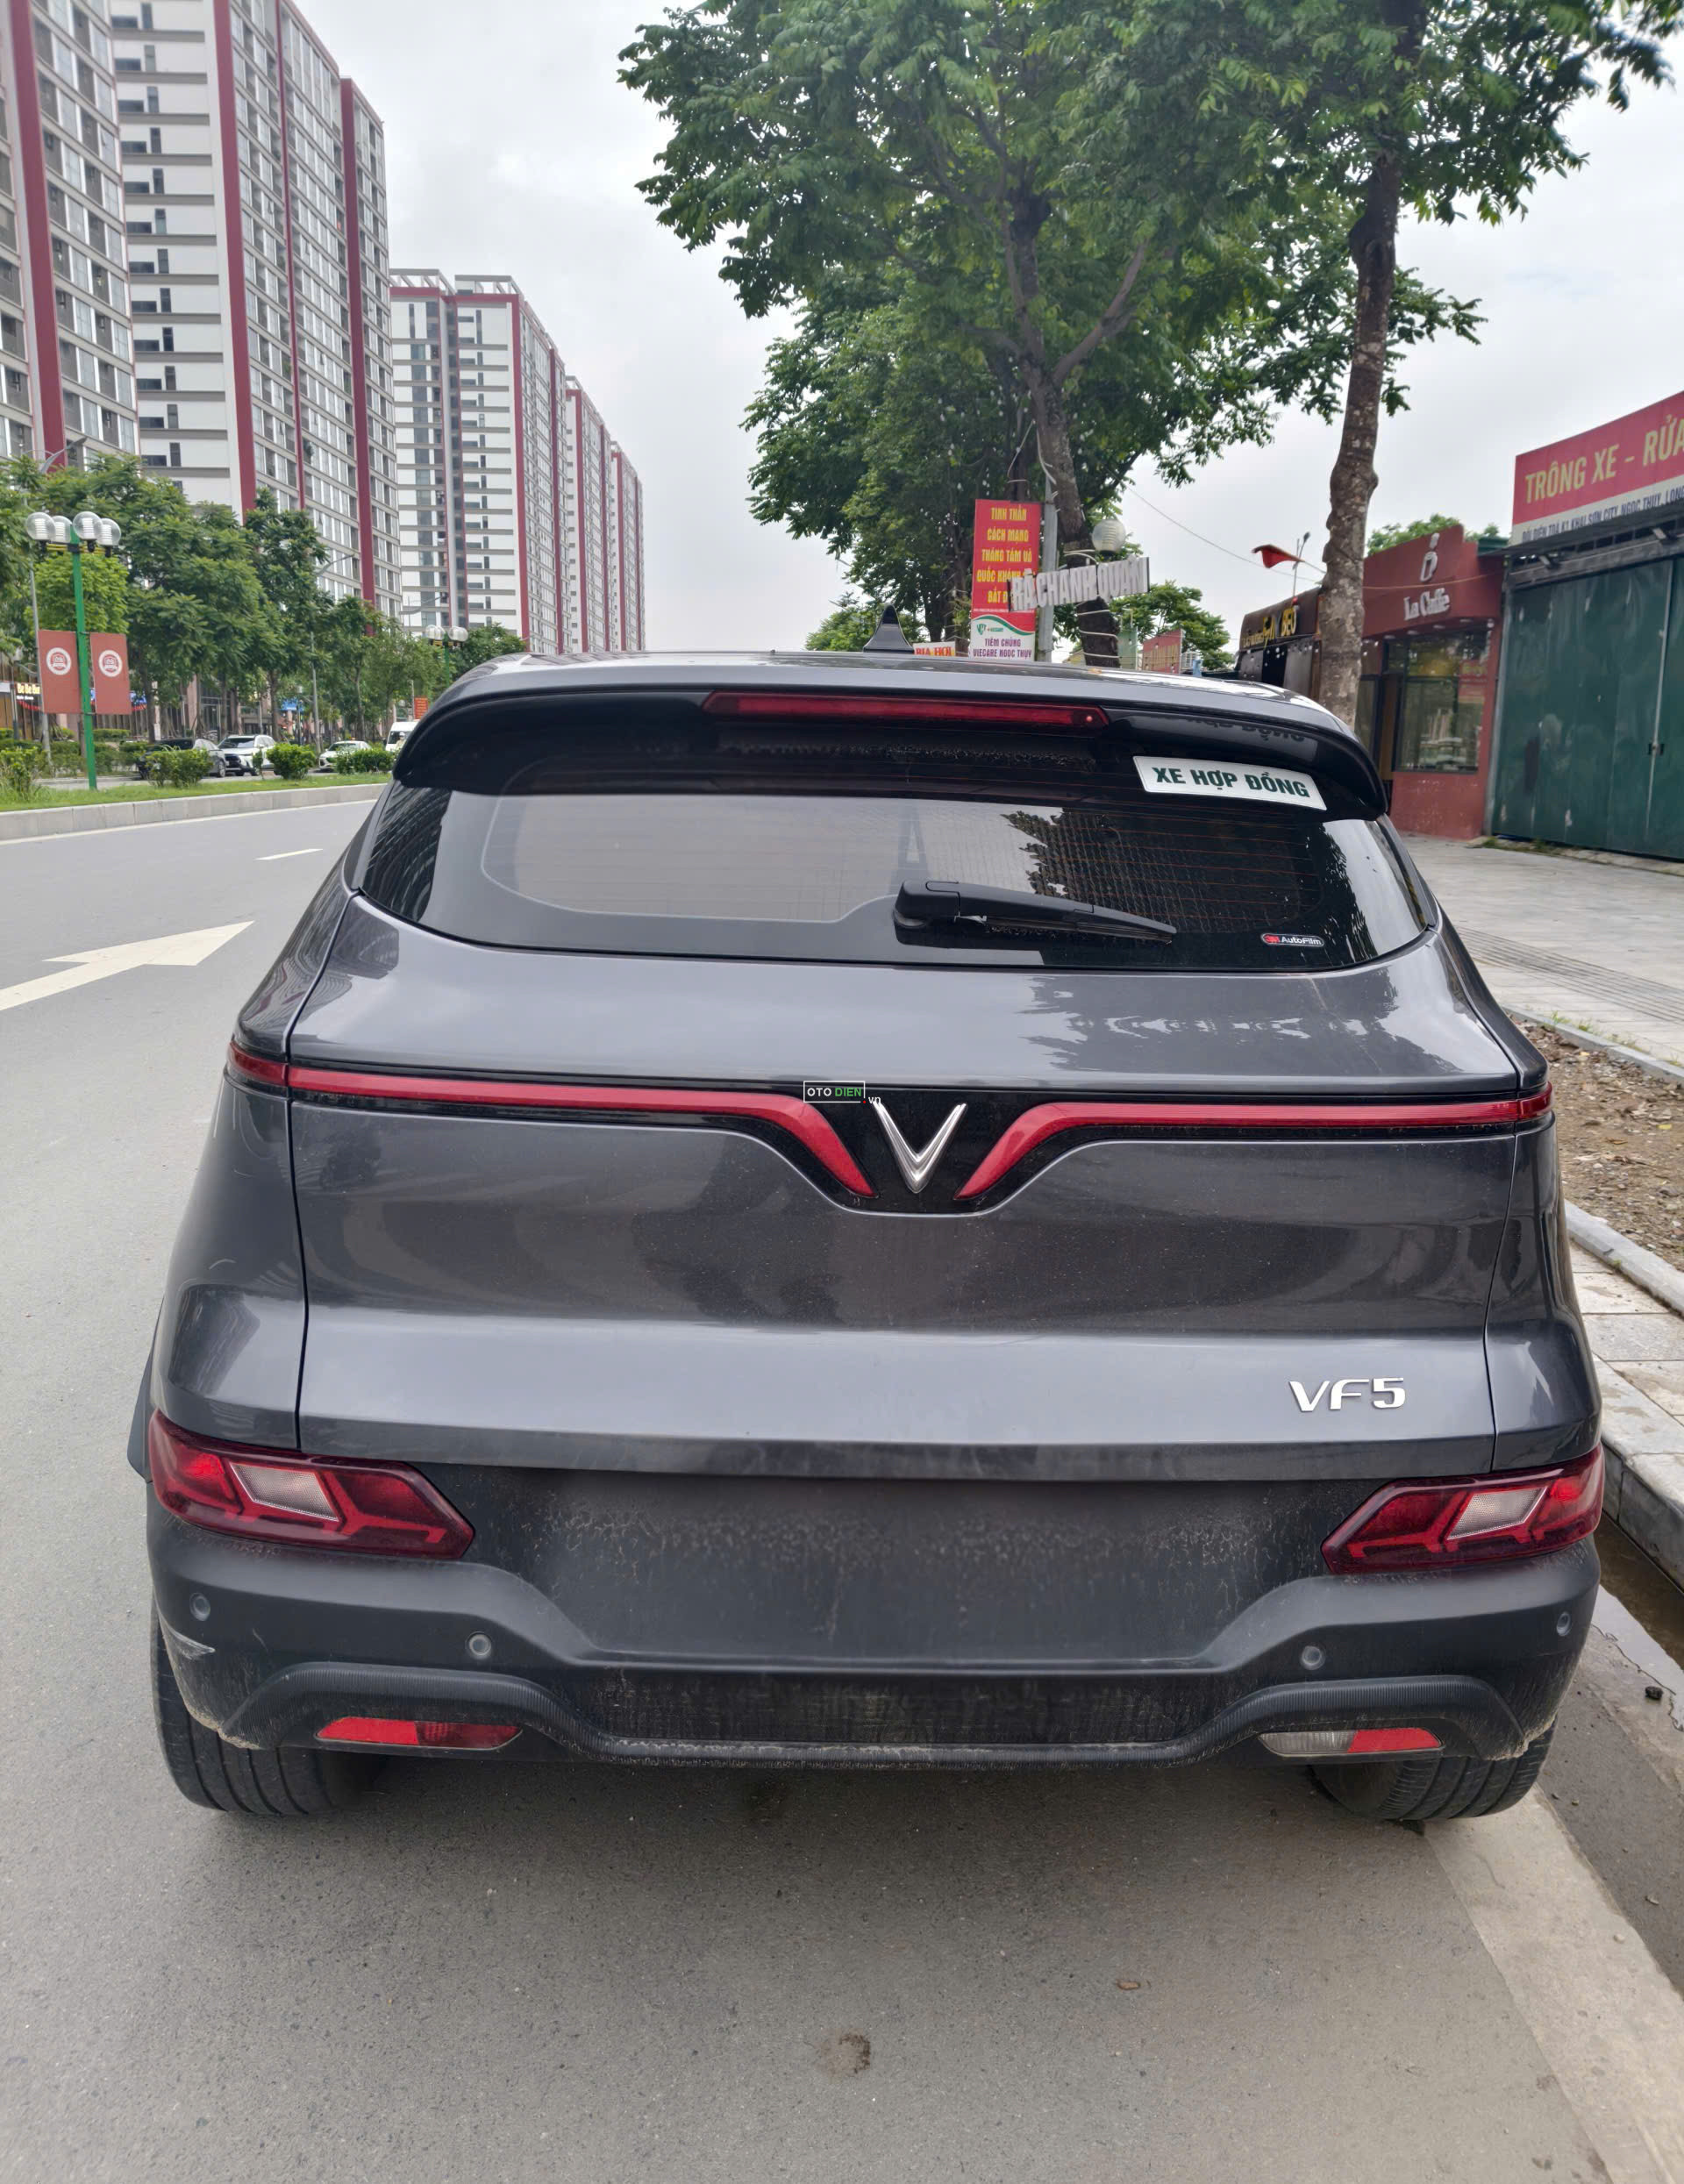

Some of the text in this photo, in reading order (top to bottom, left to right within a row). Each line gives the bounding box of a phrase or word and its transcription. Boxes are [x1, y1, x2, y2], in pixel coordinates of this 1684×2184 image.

[1524, 456, 1587, 504] TRÔNG
[1591, 444, 1619, 484] XE
[991, 507, 1007, 520] TINH
[987, 526, 1029, 545] CÁCH MẠNG
[981, 547, 1004, 562] THÁNG
[1006, 547, 1021, 562] TÁM
[976, 566, 996, 583] QUỐC
[1036, 565, 1097, 608] CHANH
[973, 648, 998, 658] VIECARE
[1152, 766, 1310, 798] XE HỢP ĐỒNG
[1281, 935, 1322, 946] AutoFilm
[1288, 1377, 1406, 1412] VF5
